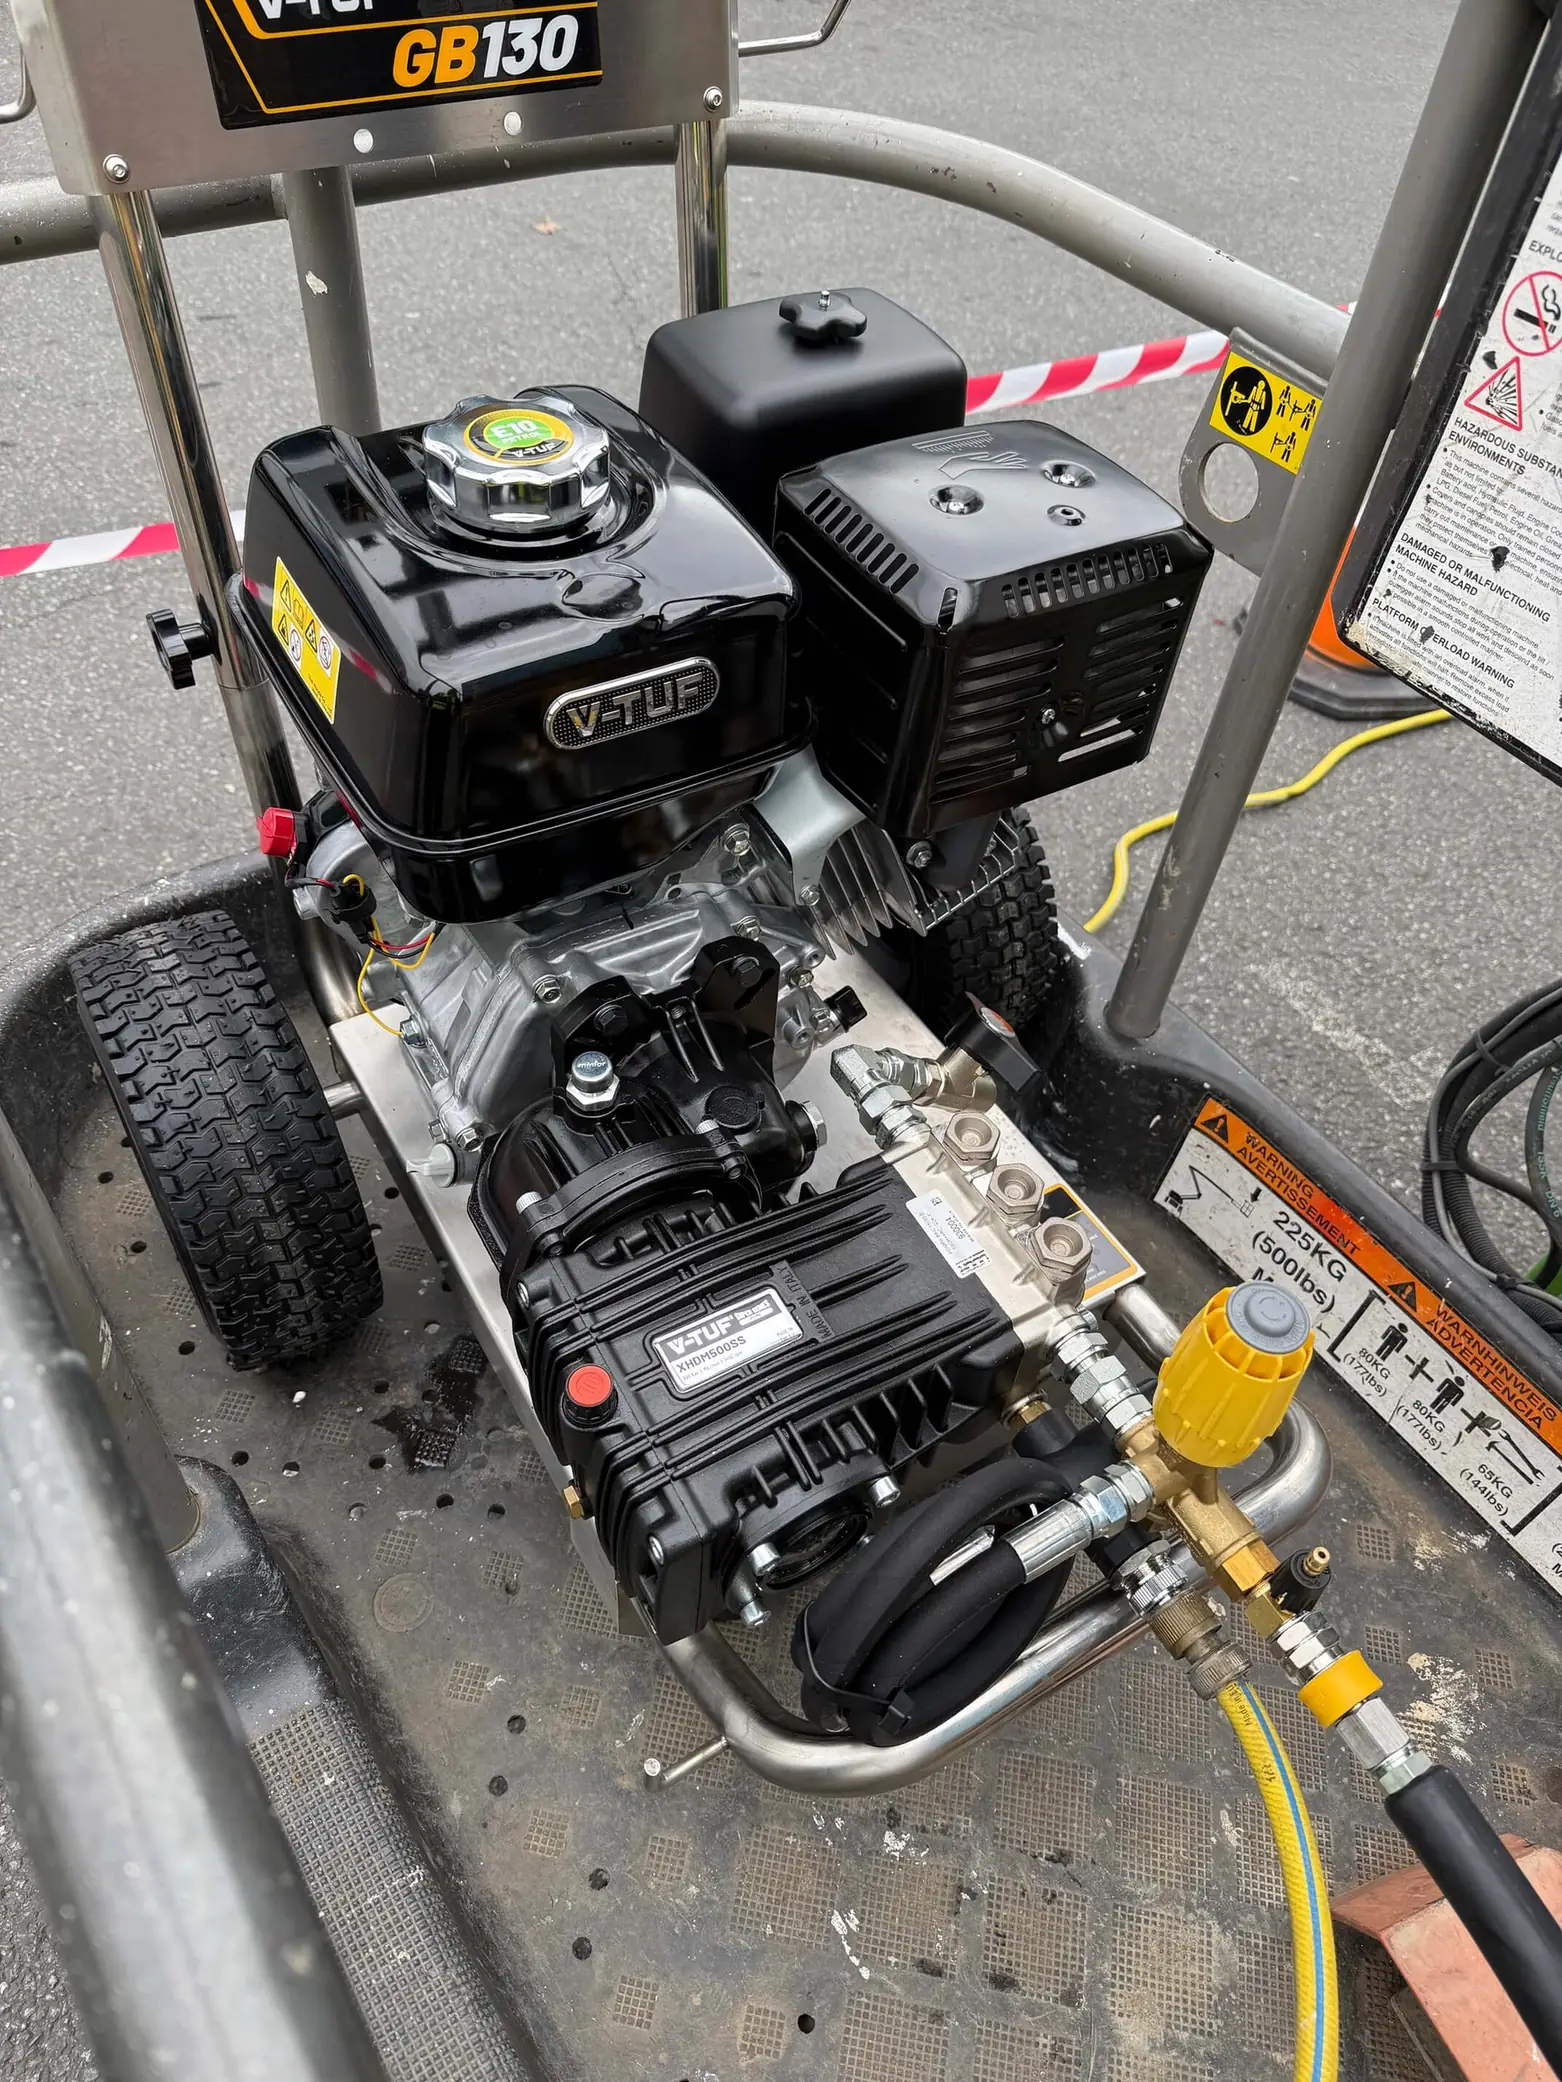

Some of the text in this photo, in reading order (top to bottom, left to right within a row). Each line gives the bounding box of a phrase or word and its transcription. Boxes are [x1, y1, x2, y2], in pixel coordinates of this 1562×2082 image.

[392, 14, 579, 88] GB130
[490, 420, 538, 439] E10
[512, 442, 556, 457] V-TUF
[1448, 430, 1526, 475] ENVIRONMENTS
[1454, 416, 1516, 454] HAZARDOUS
[1440, 468, 1462, 486] Battery
[1478, 488, 1508, 508] Hydraulic
[1526, 514, 1550, 530] Engine
[1444, 460, 1452, 468] as
[1452, 464, 1464, 474] but
[1463, 470, 1474, 478] not
[1474, 475, 1495, 490] limited
[1450, 450, 1463, 462] This
[1462, 458, 1484, 472] machine
[1483, 469, 1516, 489] contains
[1516, 486, 1541, 502] several
[1415, 522, 1448, 543] mechanical
[1432, 486, 1561, 559] Covers and canopies should remain closed
[1452, 486, 1472, 501] Diesel
[1488, 505, 1508, 521] Petrol,
[1510, 516, 1533, 533] Engine
[1460, 512, 1466, 520] in
[1498, 532, 1513, 547] Only
[1513, 542, 1536, 558] trained
[1420, 513, 1433, 527] they
[1432, 521, 1454, 536] protect
[1454, 532, 1488, 555] themselves
[1534, 576, 1550, 588] heat
[1423, 505, 1440, 518] carry
[1439, 514, 1450, 523] out
[1450, 520, 1488, 544] maintenance
[1510, 552, 1537, 570] machine,
[1395, 544, 1478, 596] MACHINE HAZARD
[1400, 532, 1551, 622] DAMAGED OR MALFUNCTIONING
[1392, 592, 1416, 610] possible
[1428, 613, 1450, 629] smooth
[1450, 626, 1480, 647] controlled
[1396, 562, 1405, 572] Do
[1405, 568, 1416, 578] not
[1416, 576, 1427, 584] use
[1432, 585, 1461, 604] damaged
[1468, 605, 1512, 634] malfunctioning
[1397, 574, 1407, 583] the
[1408, 580, 1432, 597] machine
[1432, 595, 1470, 619] malfunctions
[1470, 616, 1490, 632] during
[1487, 628, 1518, 648] operation
[1526, 649, 1537, 659] the
[1537, 656, 1546, 664] tilt
[1372, 598, 1515, 688] PLATFORM OERLOAD WARNING
[1387, 580, 1414, 596] outrigger
[1414, 595, 1428, 605] alarm
[1427, 602, 1454, 620] sounds
[1452, 618, 1467, 629] stop
[1476, 630, 1490, 641] work
[1490, 638, 1504, 650] and
[1504, 647, 1530, 666] descend
[1538, 668, 1554, 681] soon
[1401, 642, 1427, 661] functions
[1450, 672, 1474, 690] Remove
[1474, 688, 1495, 703] excess
[1496, 700, 1510, 712] load
[1422, 644, 1434, 655] with
[1442, 658, 1468, 676] overload
[1468, 674, 1486, 688] alarm,
[1488, 686, 1504, 699] when
[1444, 679, 1451, 687] to
[1451, 684, 1472, 700] restore
[566, 671, 703, 738] V-TUF
[1245, 1131, 1314, 1199] WARNING
[1237, 1146, 1361, 1255] AVERTISSEMENT
[1252, 1231, 1336, 1313] (500lbs)
[1273, 1211, 1347, 1283] 225KG
[777, 1264, 833, 1340] MADE IN ITALY
[667, 1316, 731, 1355] V-TUF
[675, 1335, 747, 1373] XHDM500SS
[1343, 1353, 1388, 1397] (177lbs)
[1358, 1347, 1391, 1380] 80KG
[1426, 1318, 1542, 1430] ADVERTENCIA
[1436, 1305, 1557, 1422] WARNHINWEIS
[1396, 1405, 1442, 1451] (177lbs)
[1412, 1399, 1446, 1433] 80KG
[1459, 1468, 1509, 1517] (144lbs)
[1477, 1464, 1514, 1499] 65KG
[1234, 1696, 1241, 1704] in
[1239, 1704, 1252, 1726] Made
